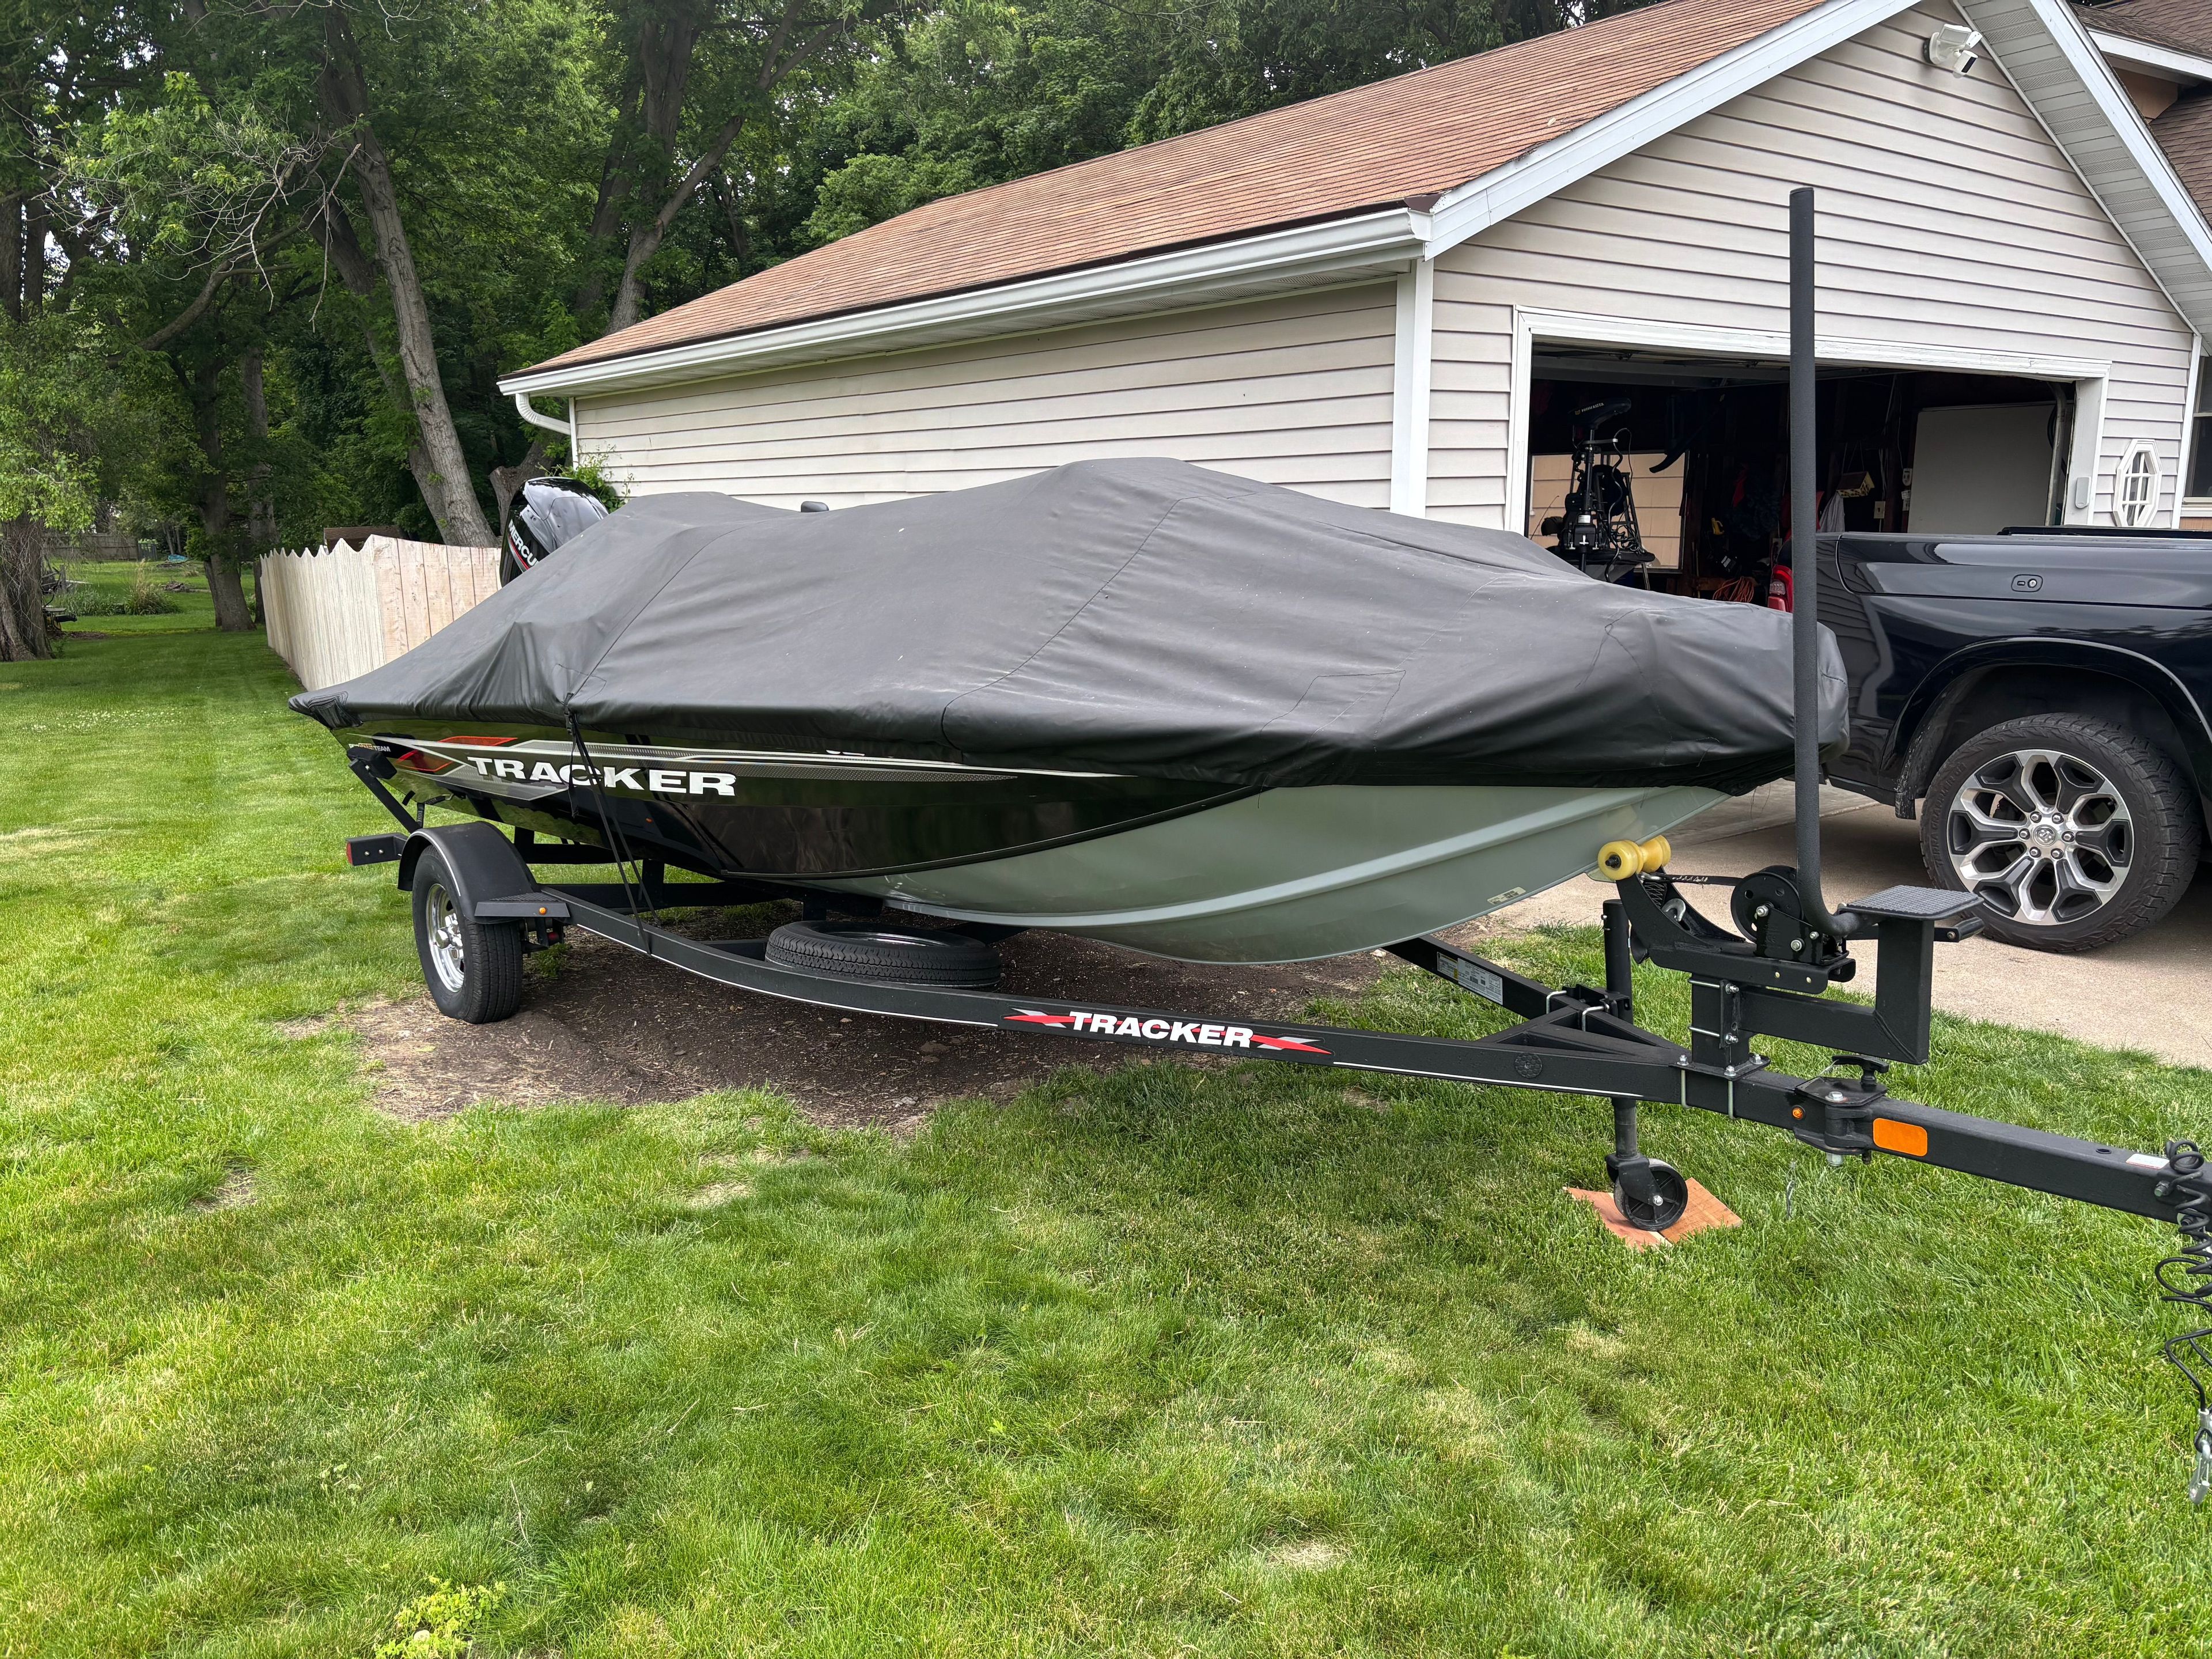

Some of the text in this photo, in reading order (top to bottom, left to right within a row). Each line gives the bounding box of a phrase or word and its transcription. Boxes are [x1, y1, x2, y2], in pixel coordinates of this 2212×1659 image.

[508, 518, 539, 567] MERCU
[467, 756, 737, 796] TRACKER
[1069, 1011, 1254, 1048] TRACKER
